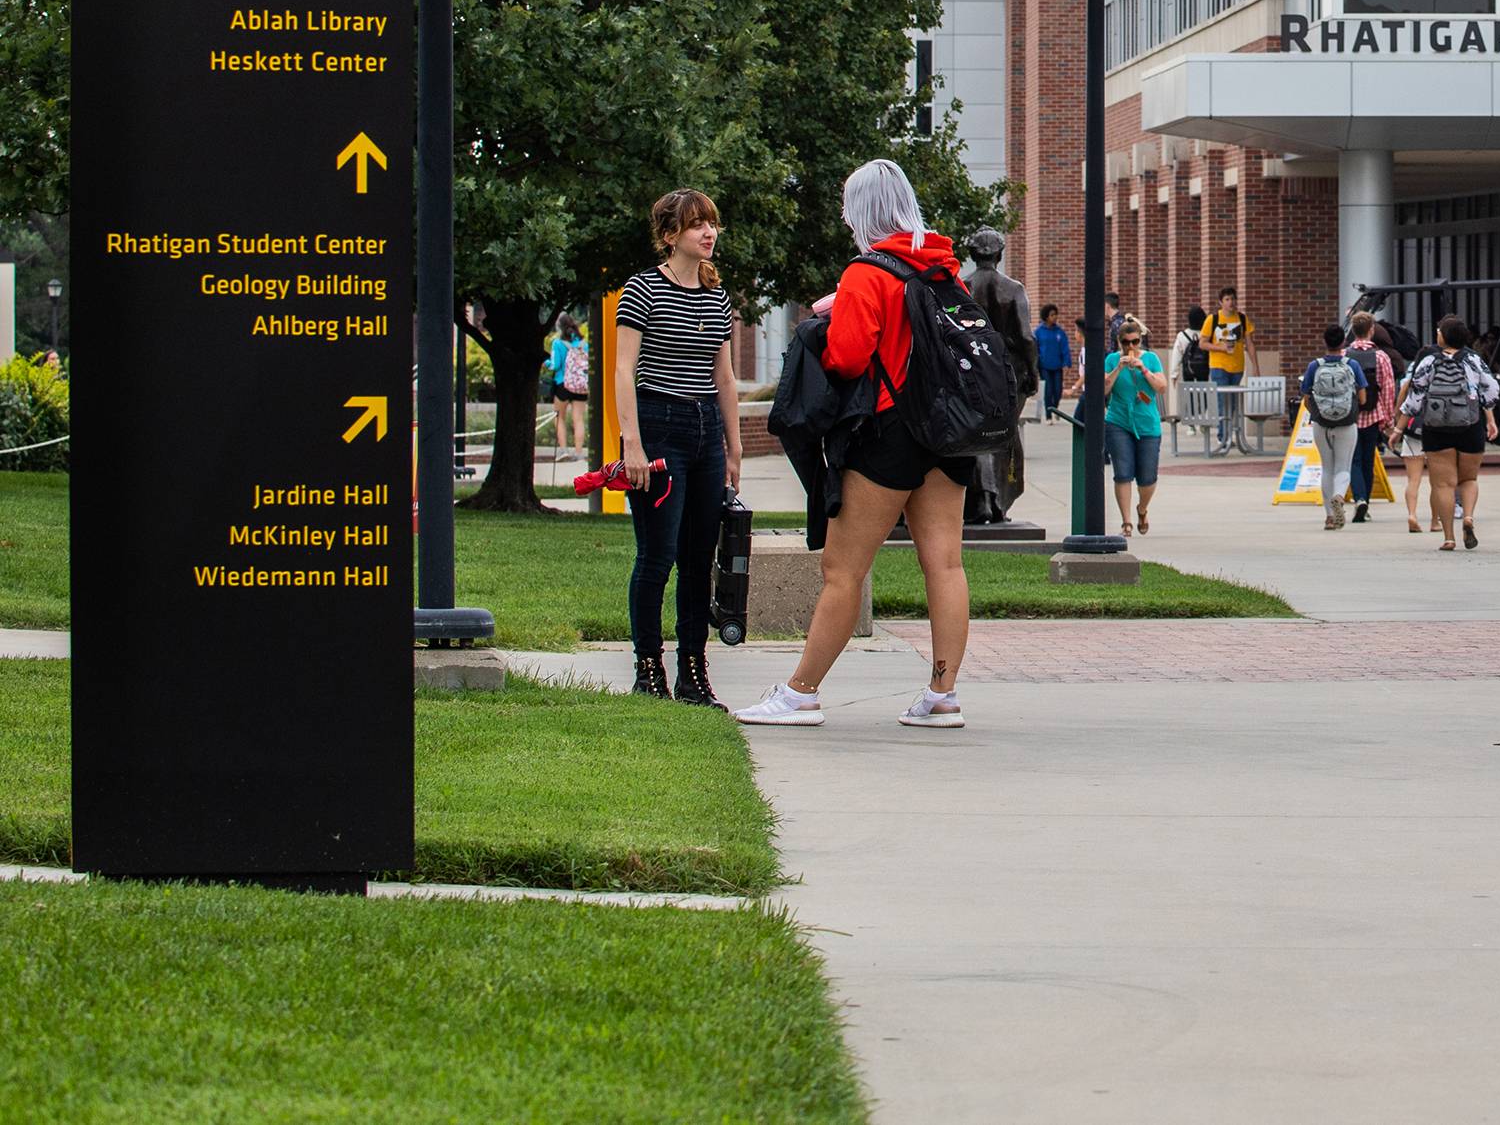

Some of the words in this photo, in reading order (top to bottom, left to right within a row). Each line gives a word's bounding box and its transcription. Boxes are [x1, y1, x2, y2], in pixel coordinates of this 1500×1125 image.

[230, 10, 298, 31] Ablah
[307, 10, 388, 37] Library
[210, 50, 304, 72] Heskett
[311, 51, 388, 73] Center
[107, 232, 211, 259] Rhatigan
[217, 233, 308, 254] Student
[314, 233, 386, 255] Center
[201, 273, 291, 300] Geology
[296, 274, 387, 301] Building
[252, 314, 339, 341] Ahlberg
[345, 315, 388, 336] Hall
[253, 484, 336, 509] Jardine
[344, 484, 388, 505] Hall
[230, 524, 336, 551] McKinley
[344, 524, 388, 546] Hall
[194, 565, 336, 587] Wiedemann
[344, 565, 388, 587] Hall
